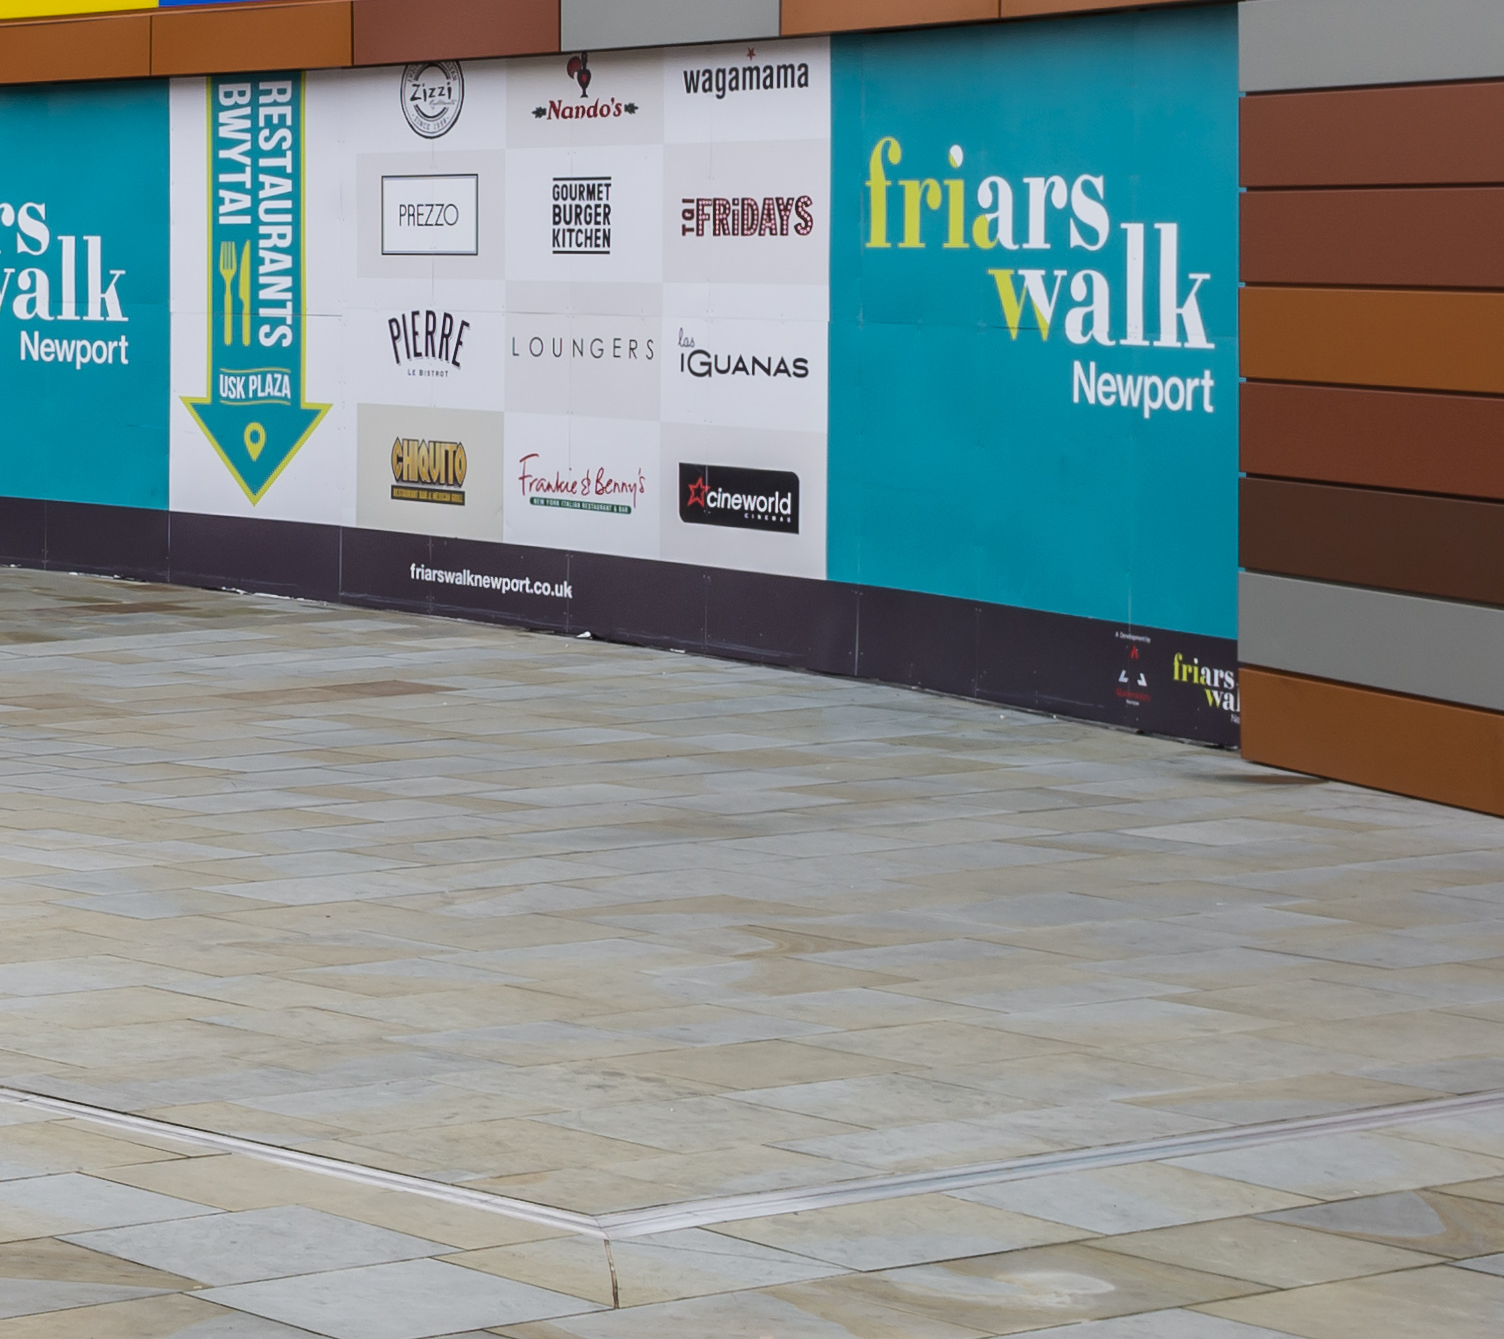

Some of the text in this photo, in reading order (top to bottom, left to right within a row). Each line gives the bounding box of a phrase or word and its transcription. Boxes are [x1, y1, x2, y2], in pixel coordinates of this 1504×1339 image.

[410, 82, 452, 102] Zizzi
[683, 62, 810, 99] wagamama
[546, 97, 622, 120] Nando's
[218, 82, 252, 224] BWYTAI
[552, 183, 612, 202] GOURMET
[865, 136, 1110, 252] friars
[257, 80, 293, 348] RESTAURANTS
[399, 203, 459, 226] PREZZO
[552, 204, 612, 226] BURGER
[681, 198, 695, 237] TGI
[552, 228, 611, 248] KITCHEN
[988, 222, 1215, 349] walk
[19, 330, 129, 370] Newport
[388, 309, 471, 370] PIERRE
[512, 336, 655, 361] LOUNGERS
[678, 327, 695, 348] las
[219, 372, 291, 400] USK PLAZA
[419, 370, 449, 378] BISTROT
[1072, 360, 1214, 418] Newport
[391, 436, 467, 489] CHIQUITO
[518, 453, 577, 496] Frankie
[595, 466, 646, 509] Benny's
[706, 487, 792, 515] cineworld
[409, 563, 573, 599] friarswalknewport.co.uk
[1173, 652, 1235, 690] friars
[1204, 687, 1241, 712] wal
